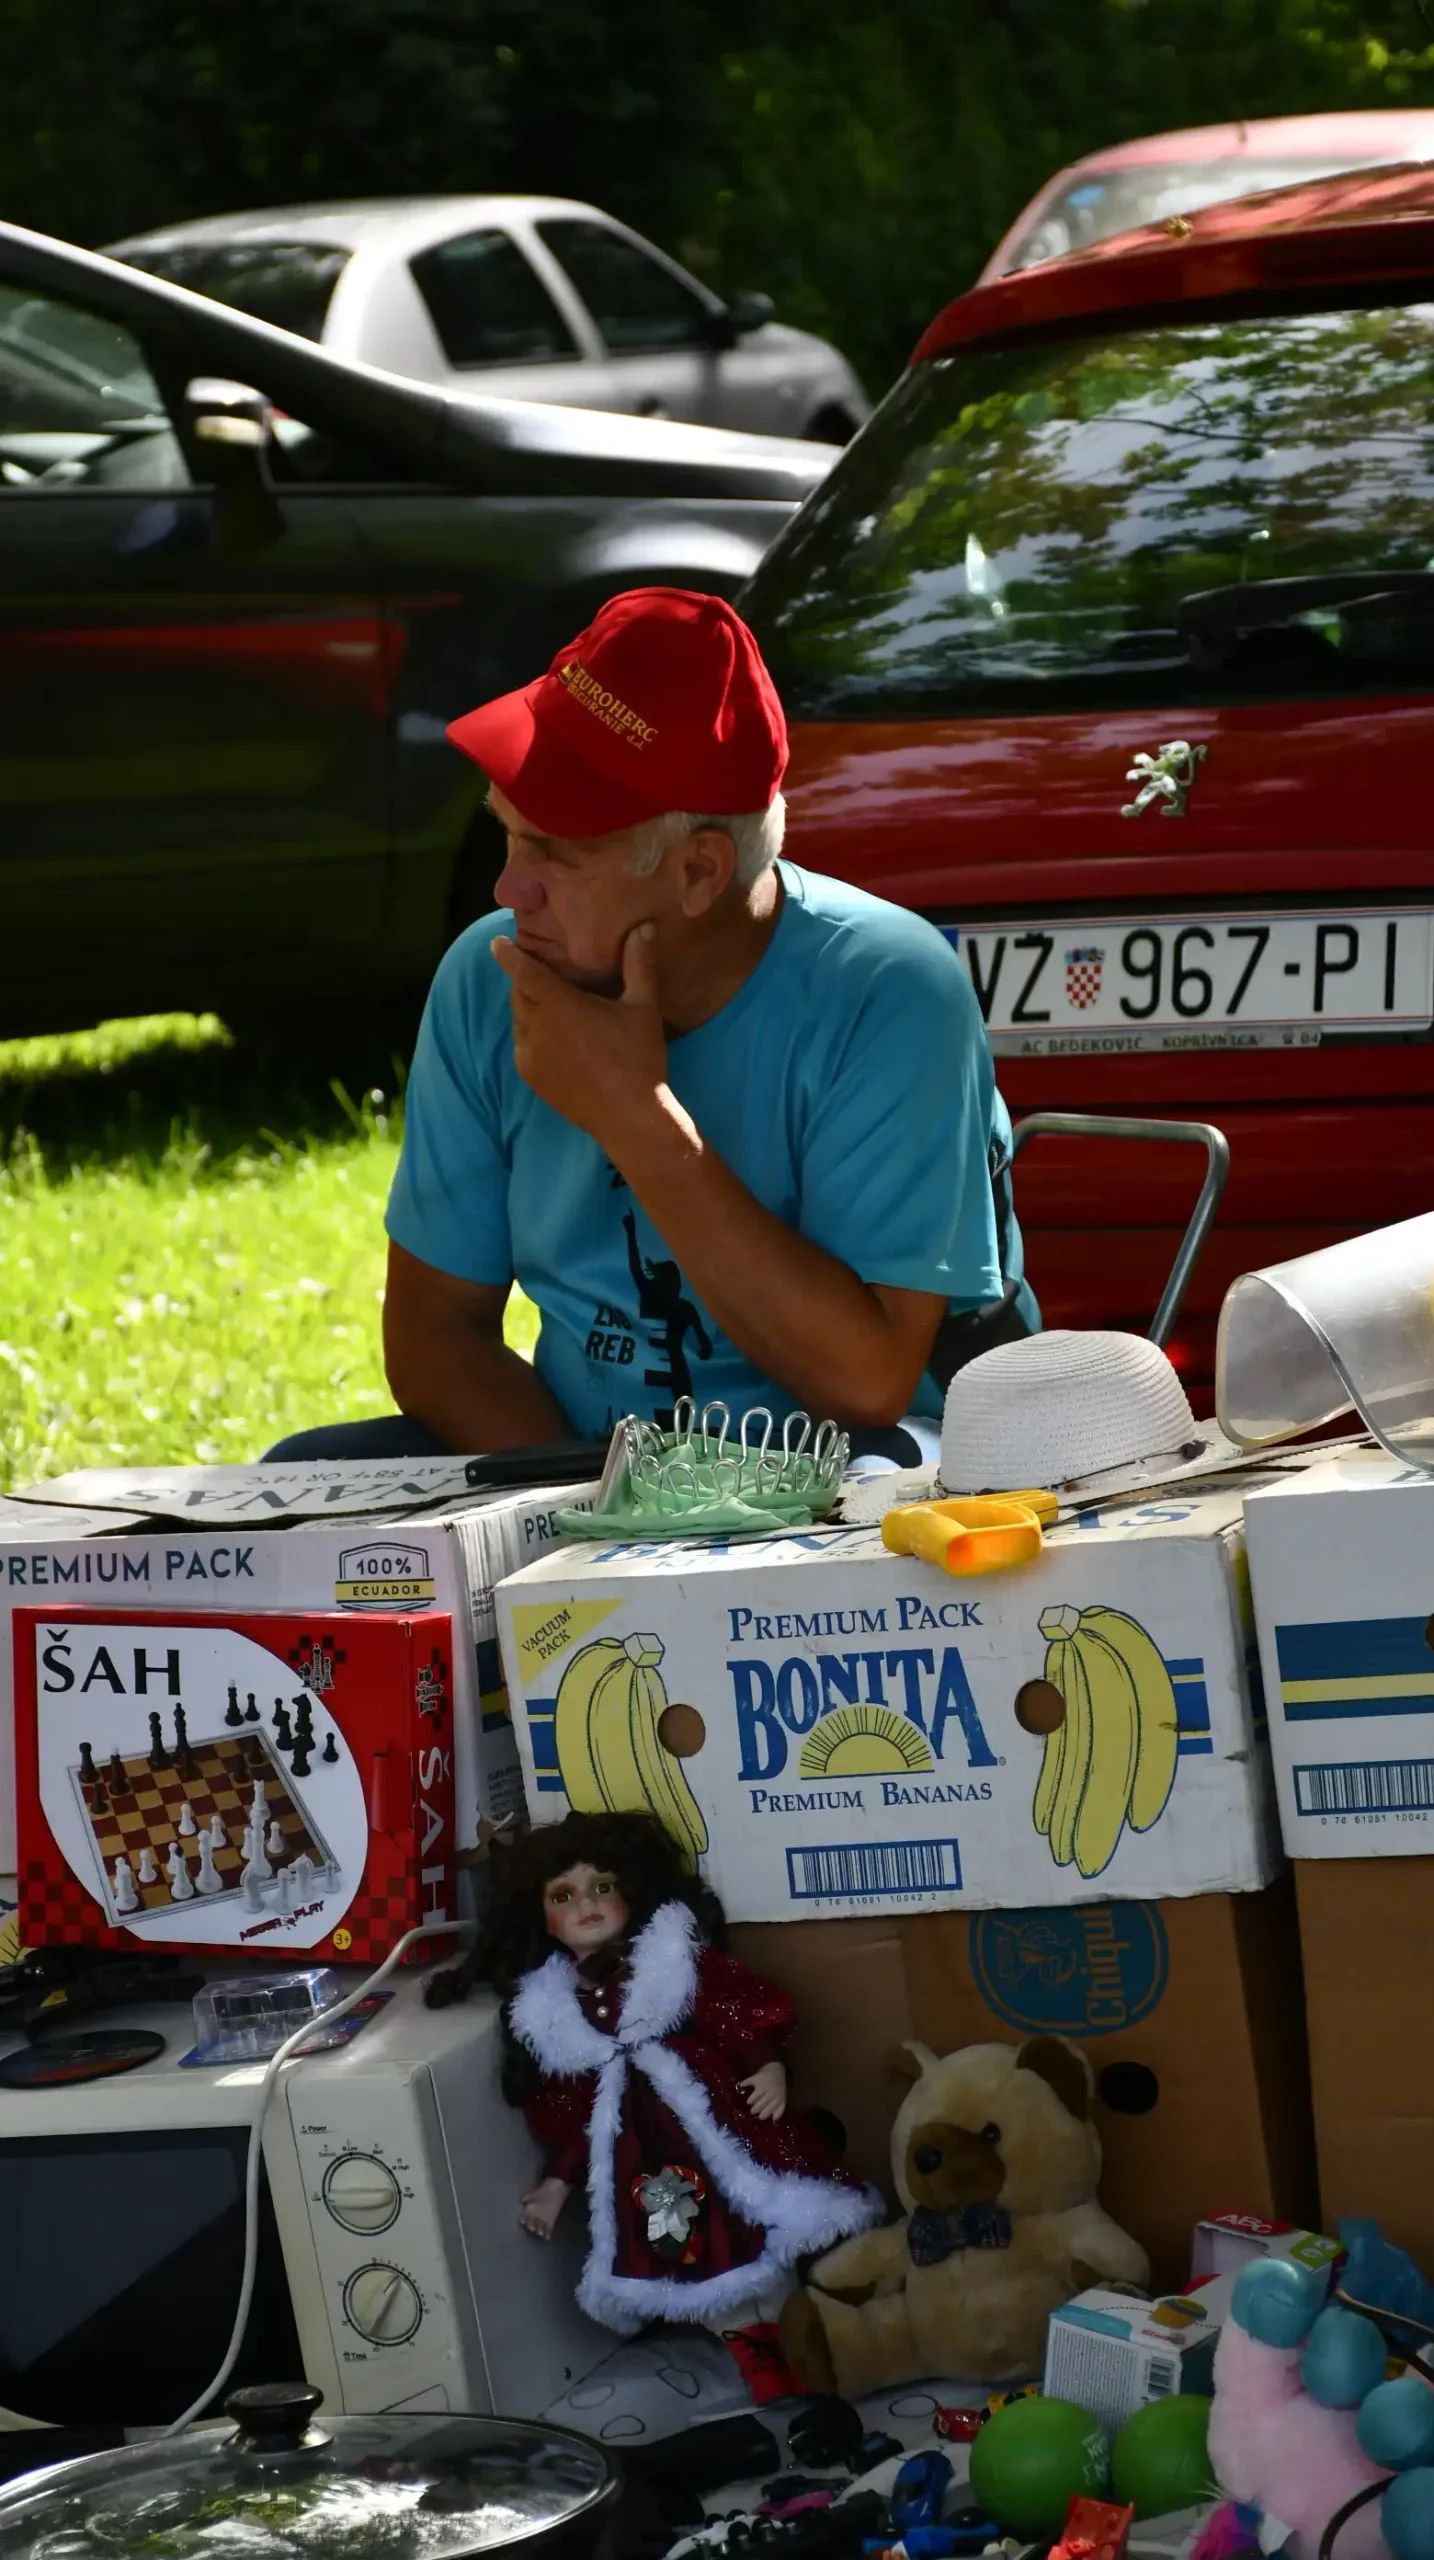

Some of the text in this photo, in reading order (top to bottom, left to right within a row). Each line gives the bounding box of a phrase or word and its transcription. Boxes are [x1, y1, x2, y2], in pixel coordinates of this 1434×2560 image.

[572, 667, 659, 742] EUROHERC
[966, 922, 1398, 1024] VŽ 967-PI
[585, 1330, 637, 1366] REB
[0, 1547, 255, 1586] REMIUM PACK
[356, 1557, 411, 1575] 100%
[352, 1585, 421, 1596] ECUADOR
[521, 1608, 572, 1653] VACUUM
[727, 1596, 984, 1642] PREMIUM PACK
[42, 1628, 182, 1695] ŠAH
[537, 1629, 572, 1660] PACK
[726, 1647, 999, 1782] BONITA
[749, 1781, 994, 1814] PREMIUM BANANAS
[418, 1746, 452, 1925] ŠAH
[335, 1933, 350, 1946] 3+
[1072, 1906, 1131, 2027] Chiqui
[1215, 2212, 1273, 2235] ABC
